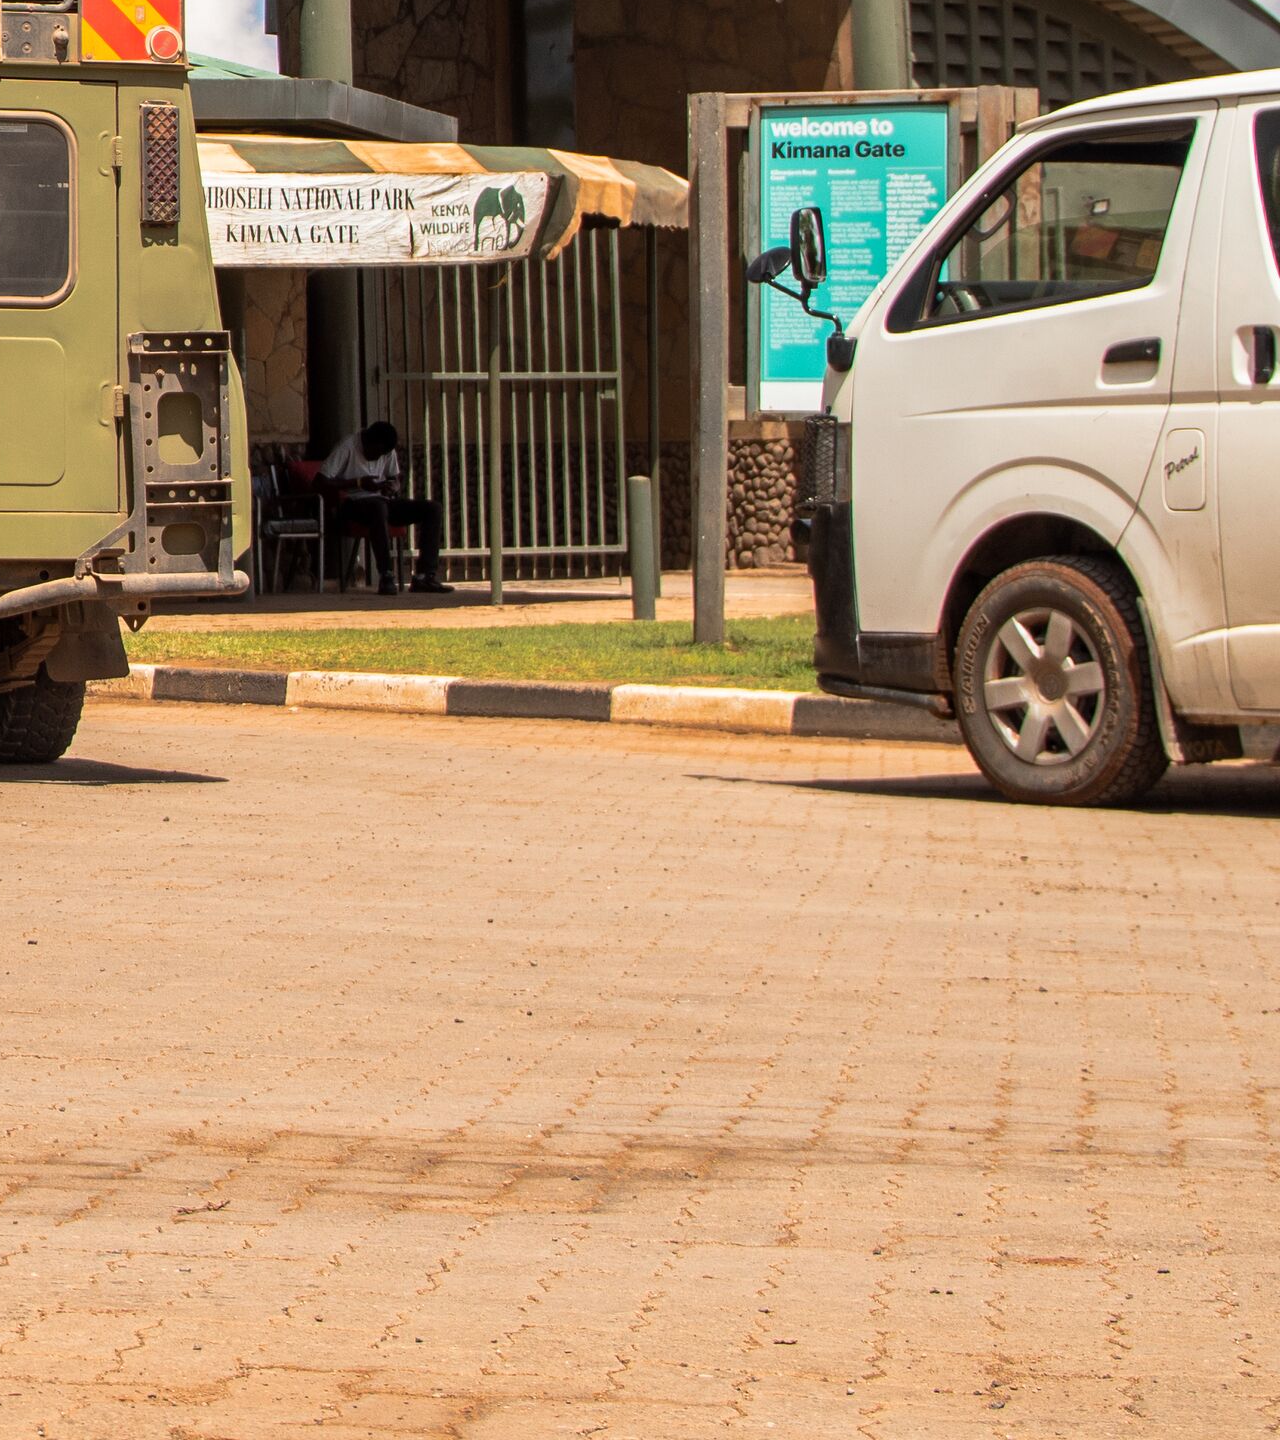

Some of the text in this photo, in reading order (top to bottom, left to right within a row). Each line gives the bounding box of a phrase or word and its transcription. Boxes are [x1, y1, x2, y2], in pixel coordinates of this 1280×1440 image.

[770, 117, 894, 137] welcome to
[771, 140, 905, 158] Kimana Gate
[206, 186, 415, 210] BOSELI NATIONAL PARK
[431, 204, 471, 217] KENYA
[226, 224, 359, 243] KIMANA GATE
[420, 222, 470, 235] WILDLIFE
[1164, 445, 1200, 480] Petrol
[1183, 740, 1226, 757] YOTA
